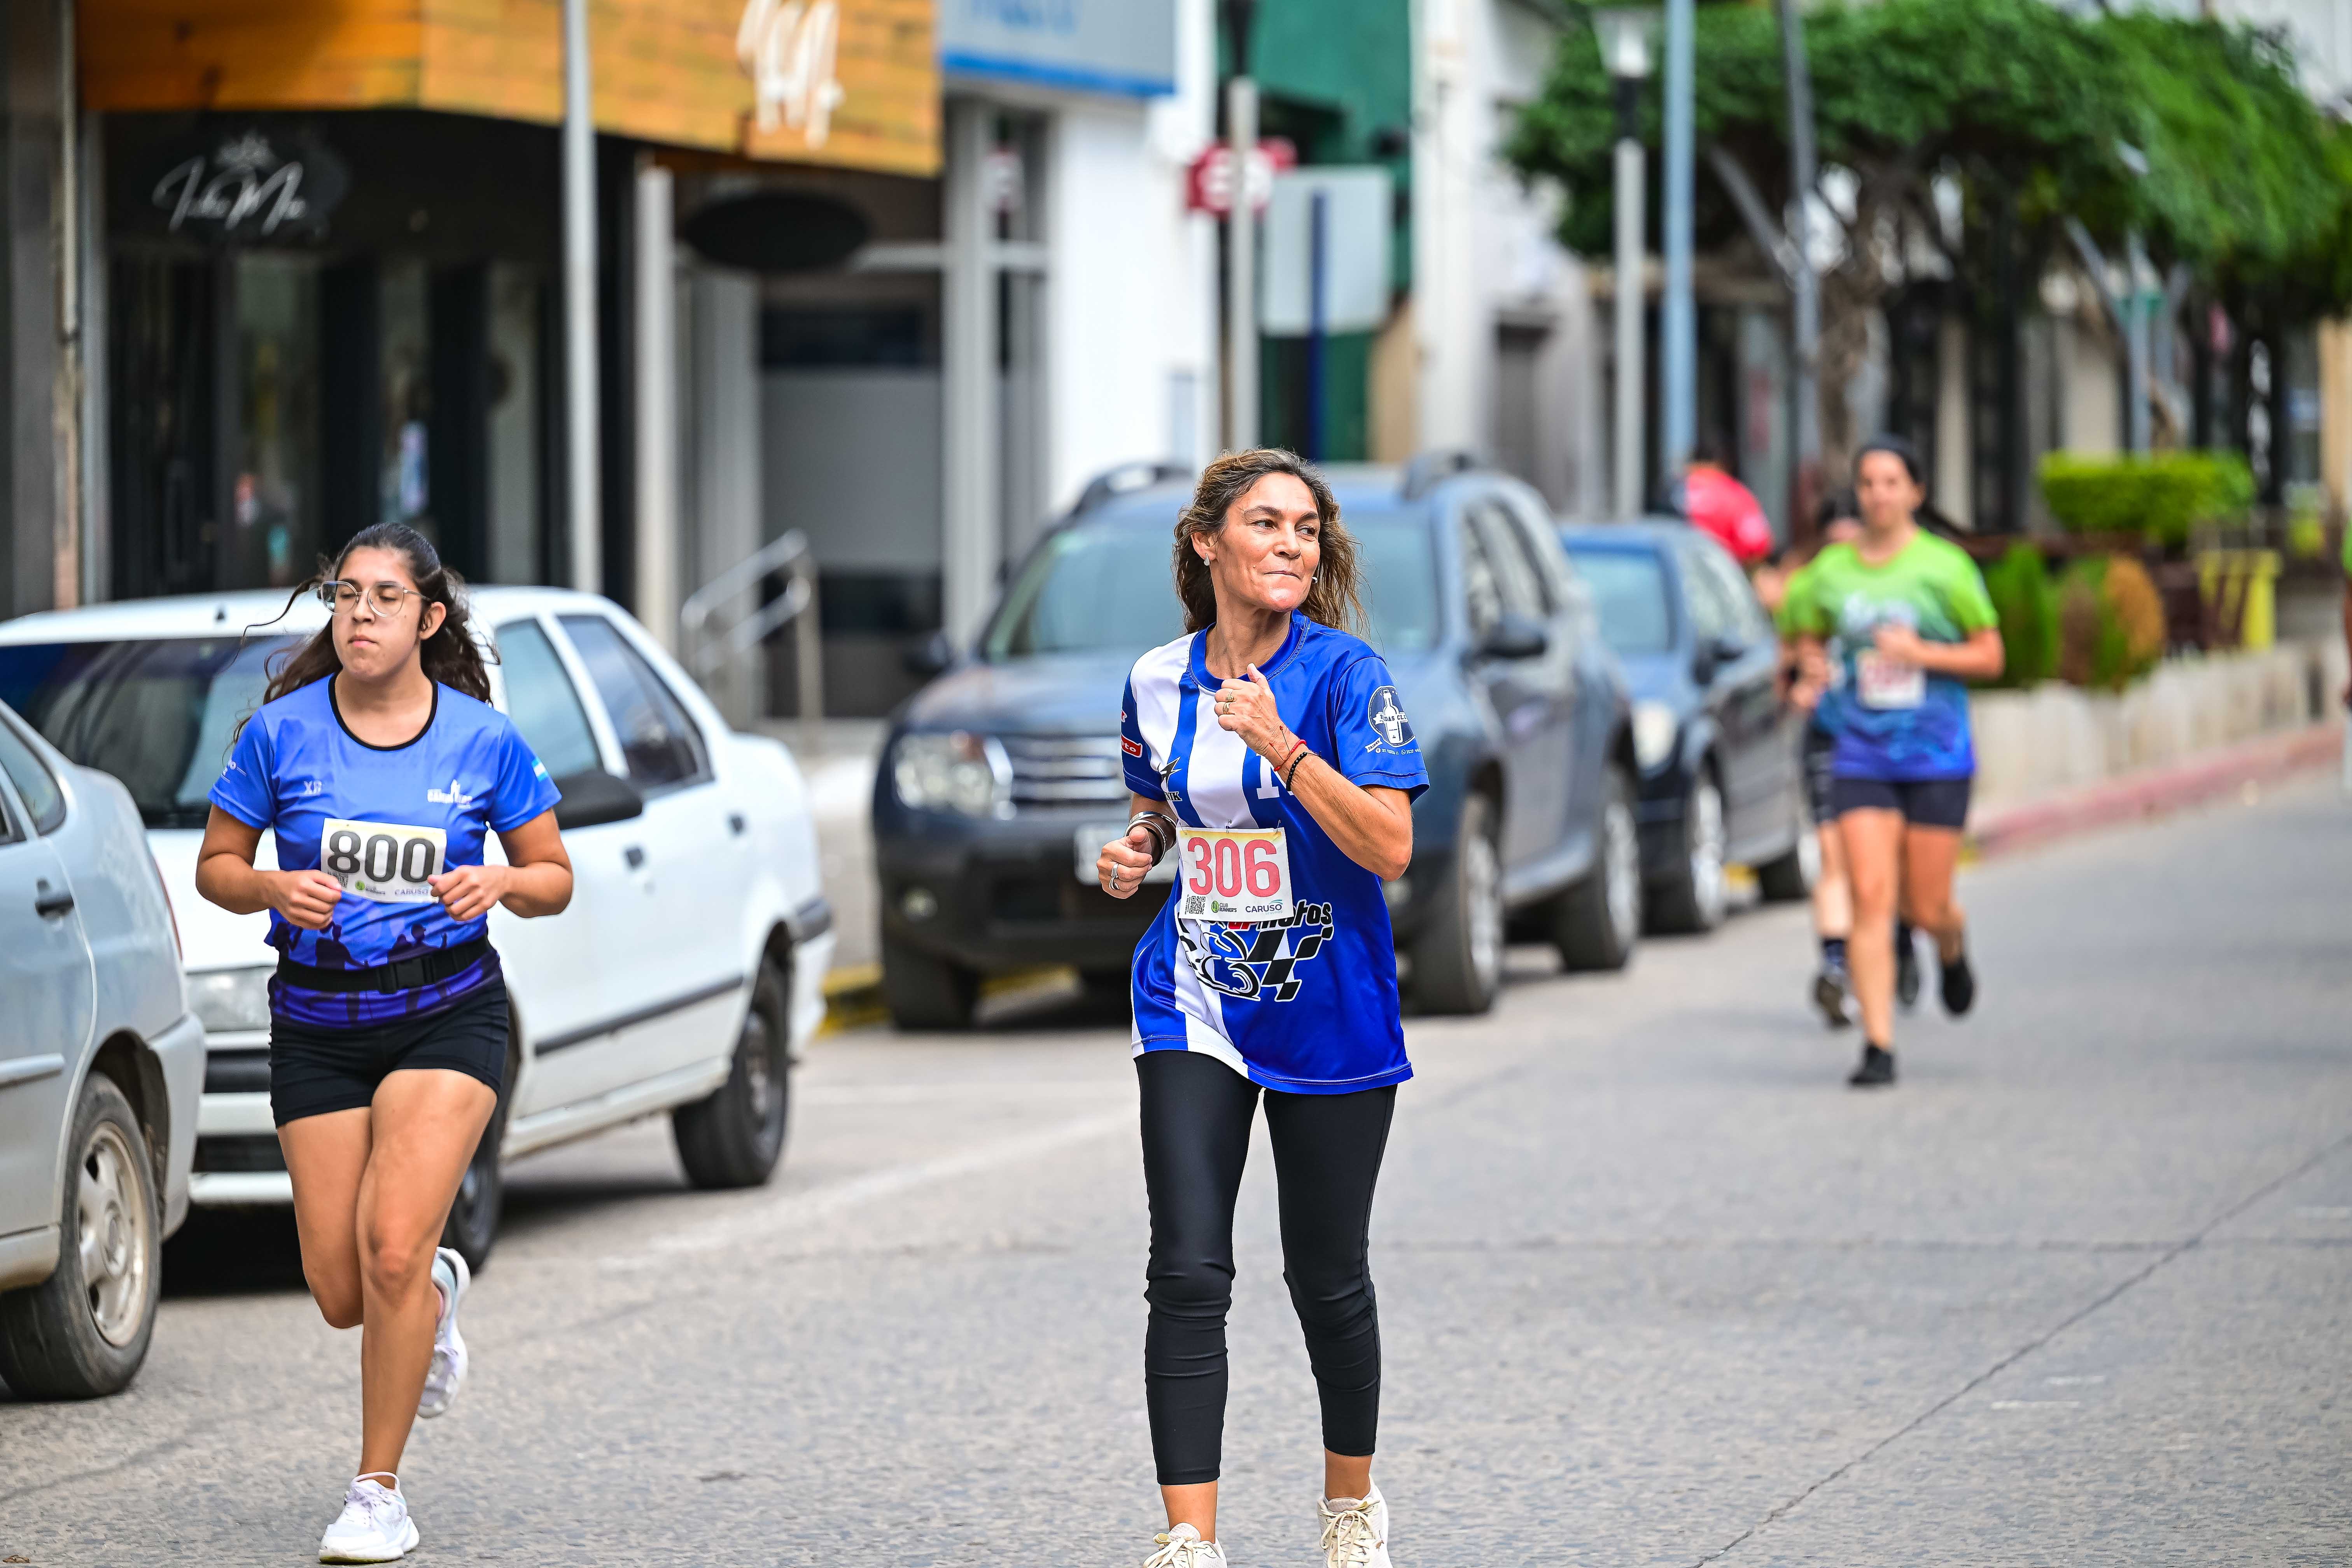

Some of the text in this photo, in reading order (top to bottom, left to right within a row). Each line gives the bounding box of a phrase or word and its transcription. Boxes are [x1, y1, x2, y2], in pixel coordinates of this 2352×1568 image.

[1121, 740, 1136, 752] to
[327, 831, 436, 882] 800
[1187, 837, 1281, 898] 306
[1245, 904, 1282, 912] CARUSO
